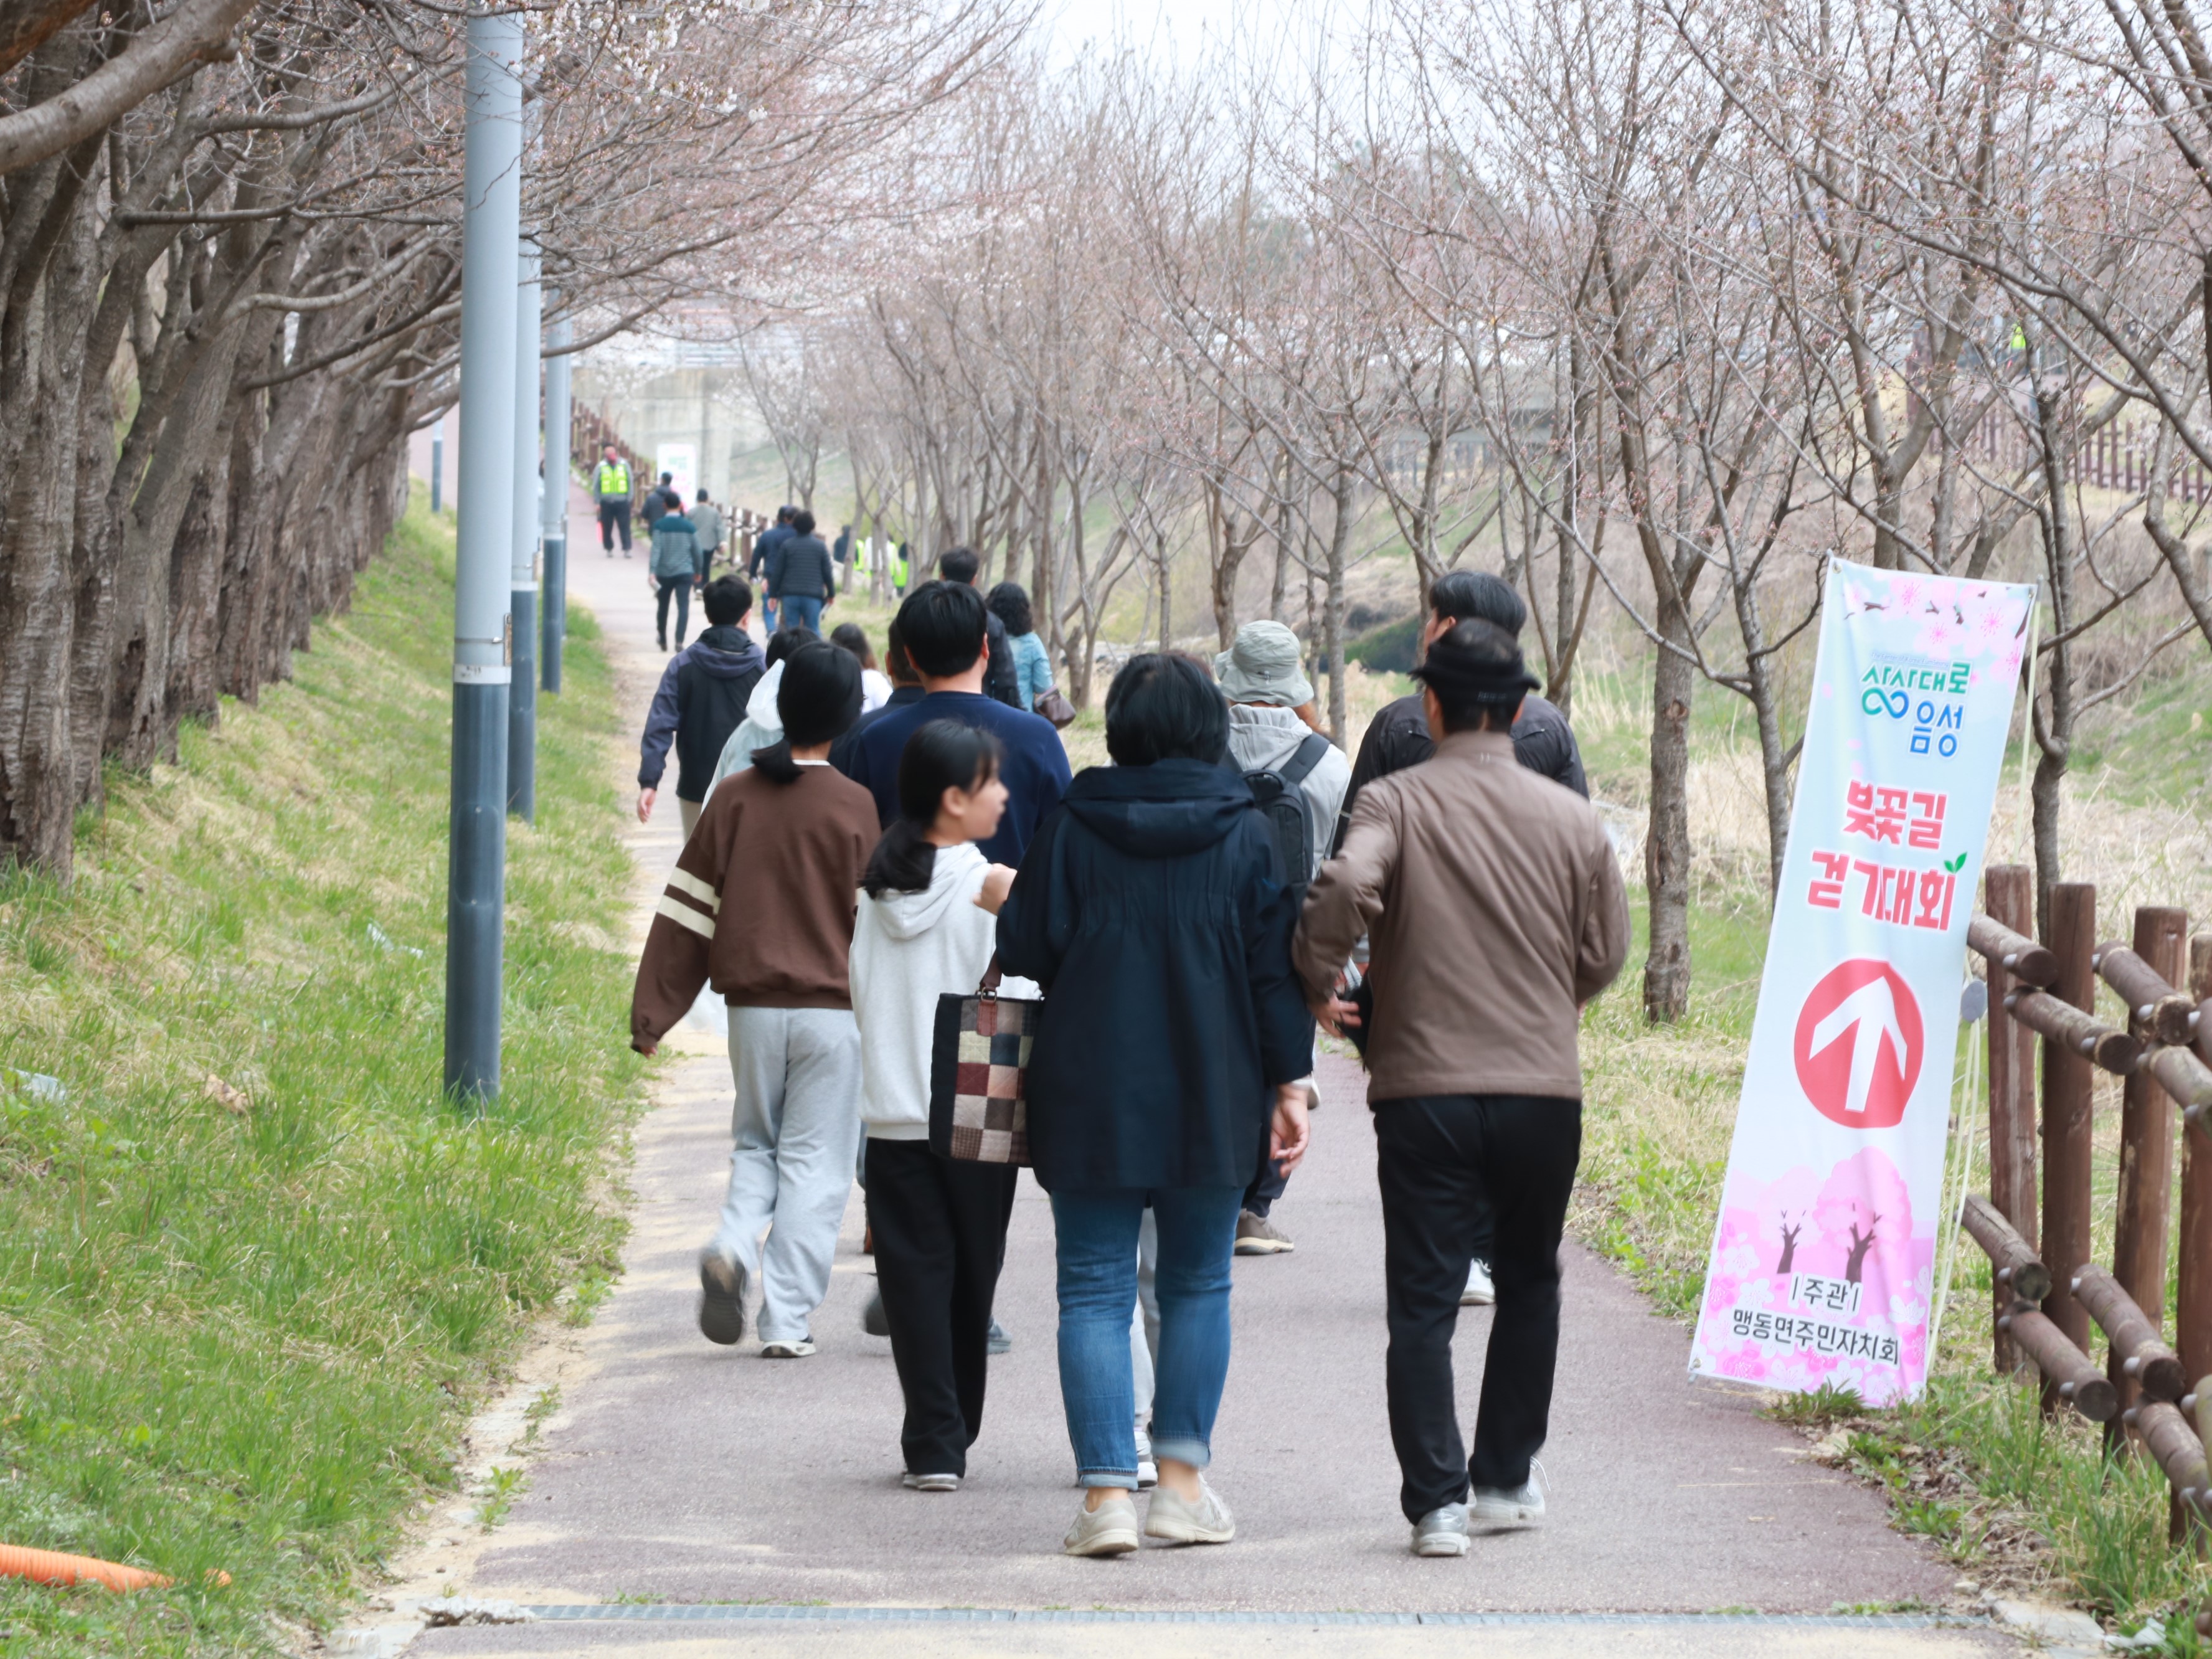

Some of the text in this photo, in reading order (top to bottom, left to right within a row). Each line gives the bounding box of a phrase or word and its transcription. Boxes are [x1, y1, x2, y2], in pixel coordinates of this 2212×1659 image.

[1910, 700, 1964, 757] 음성
[1843, 779, 1947, 850] 벚꽃길
[1808, 851, 1955, 931] 걷기대회
[1734, 1309, 1899, 1365] 맹동면주민자치회
